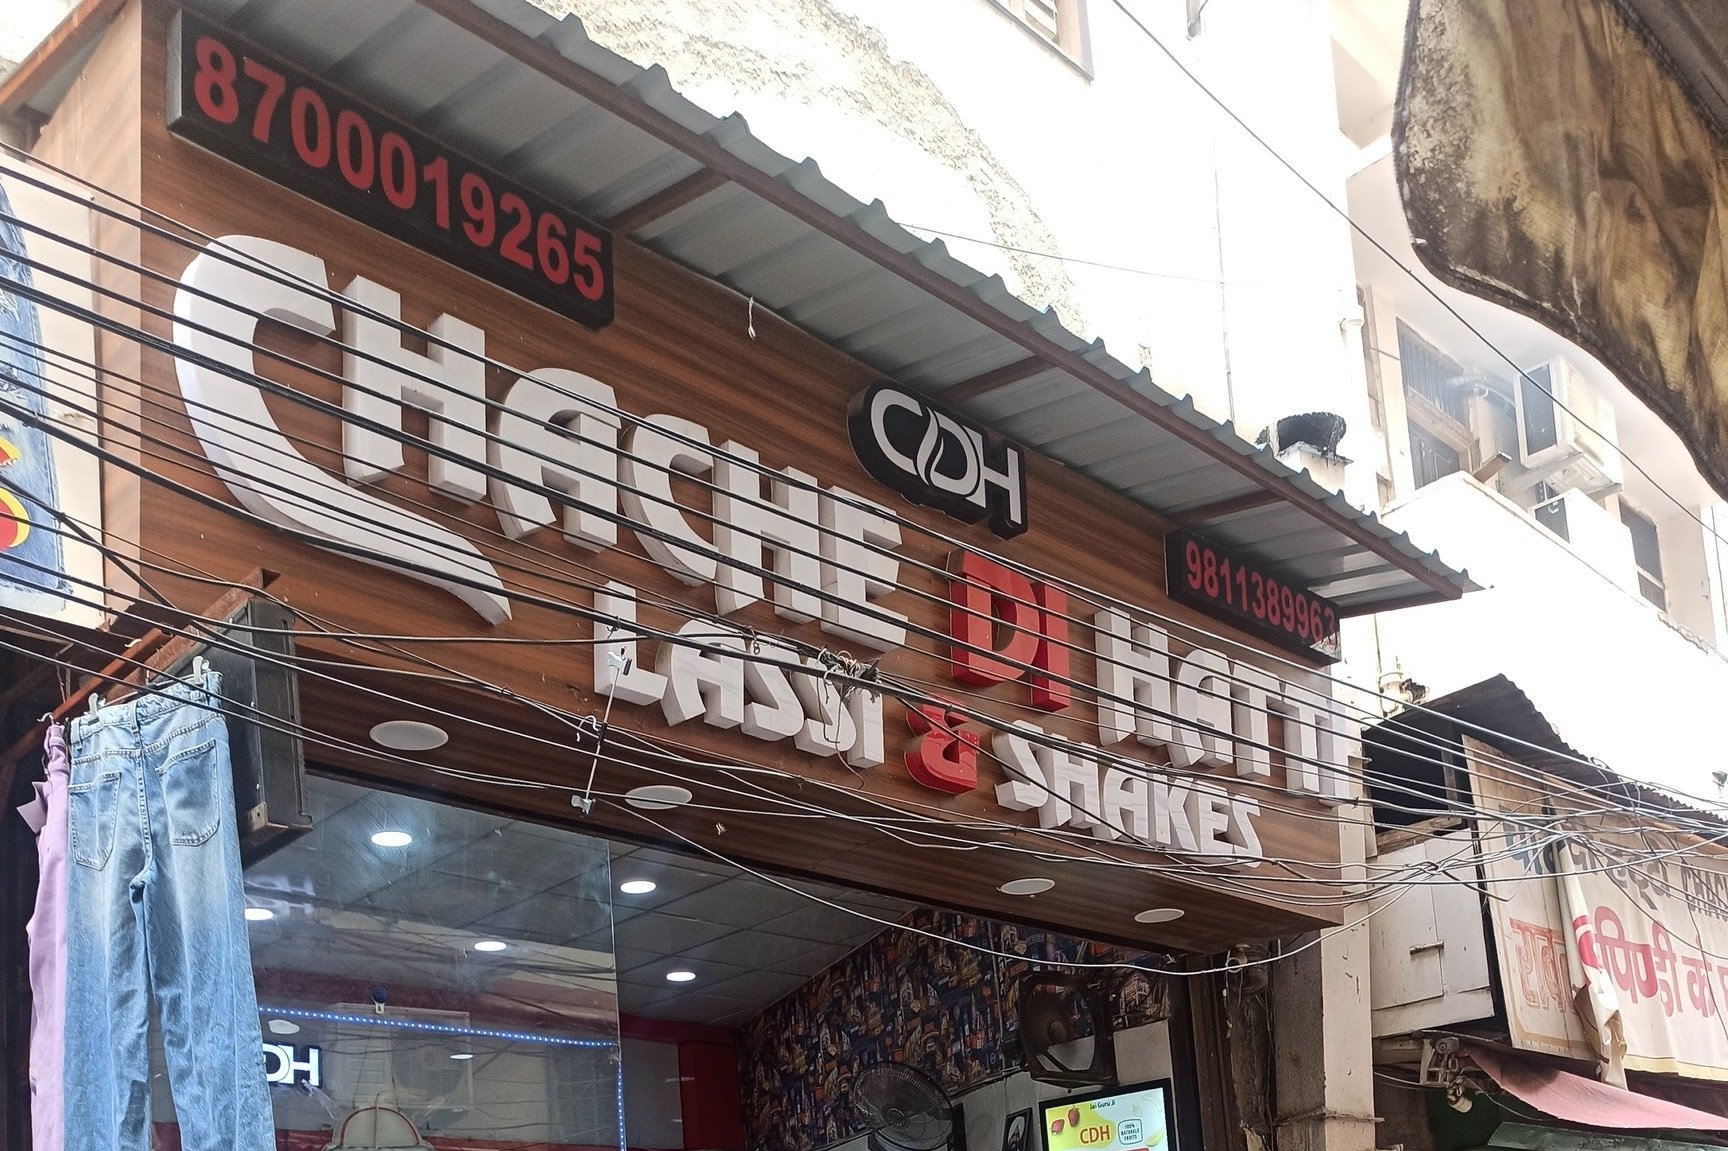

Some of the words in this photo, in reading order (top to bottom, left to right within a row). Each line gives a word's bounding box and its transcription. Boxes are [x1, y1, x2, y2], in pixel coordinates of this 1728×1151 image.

[193, 36, 604, 302] 8700019265
[173, 234, 908, 652] CHACHE
[948, 550, 1071, 713] DI
[1094, 606, 1351, 807] HATTI
[870, 389, 1024, 526] CDH
[594, 581, 885, 769] LASSI
[903, 694, 981, 796] &
[995, 720, 1263, 870] SHAKES
[1079, 1124, 1110, 1144] CDH
